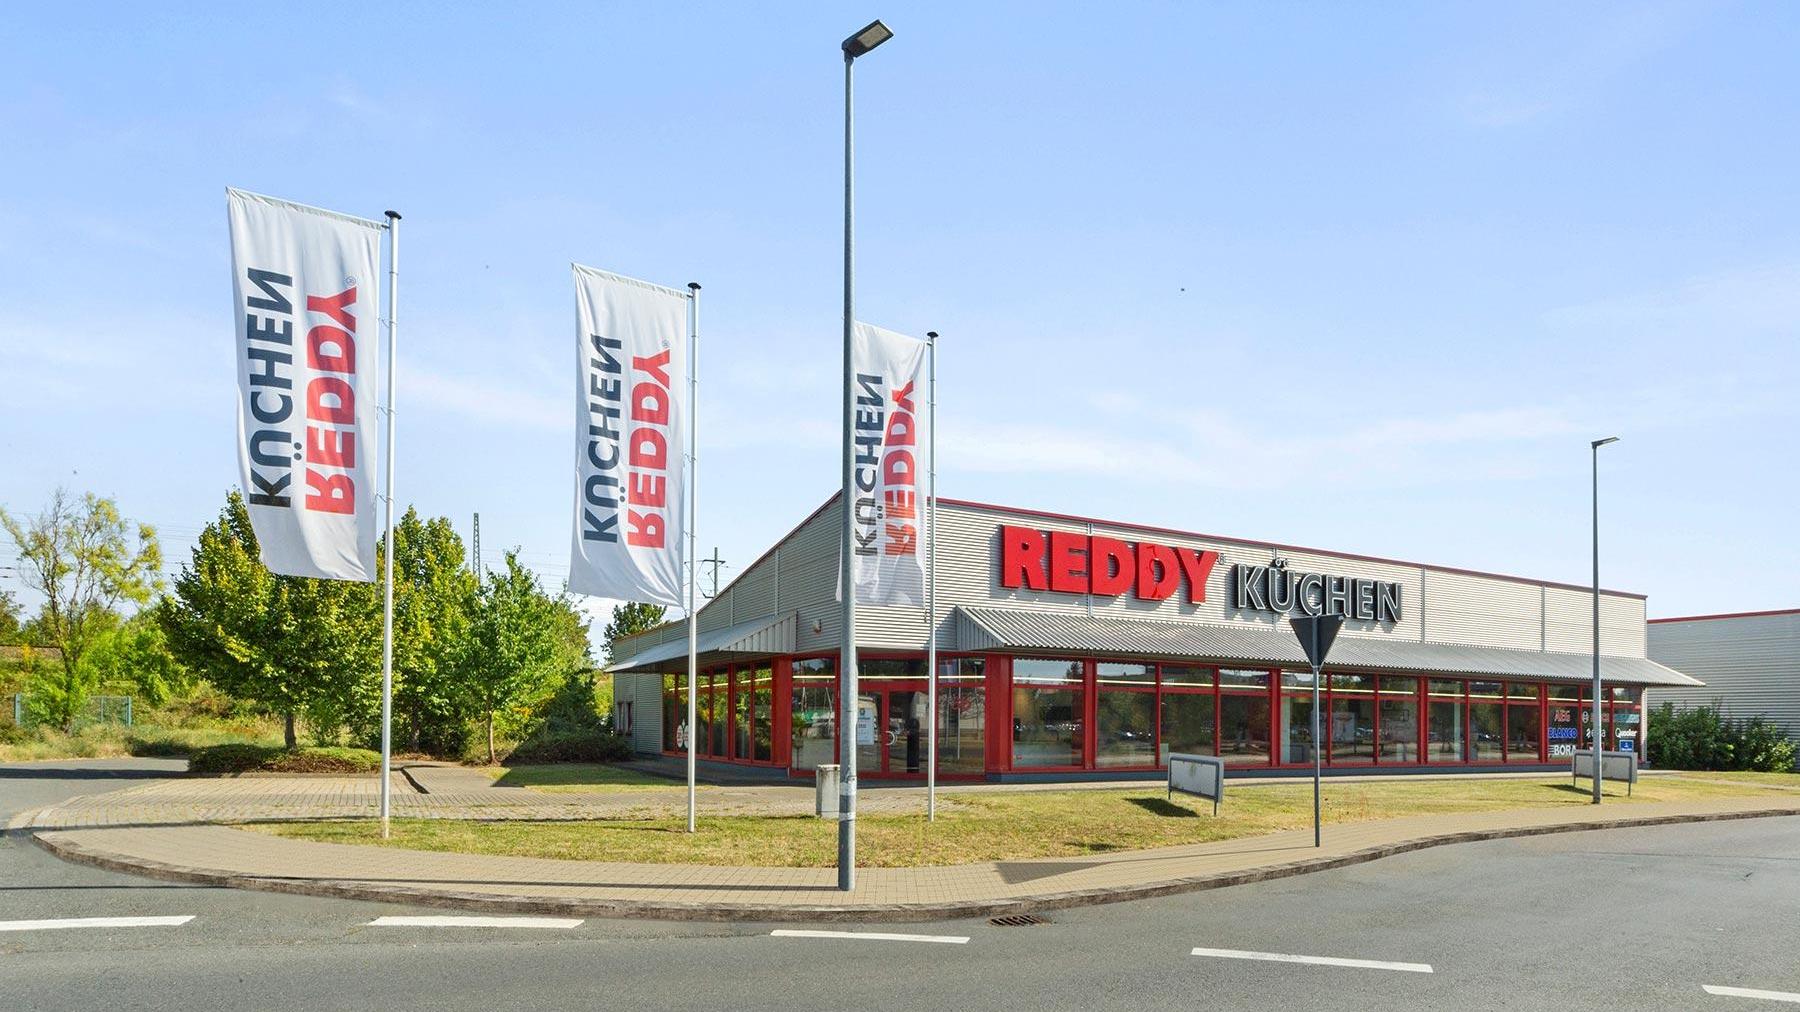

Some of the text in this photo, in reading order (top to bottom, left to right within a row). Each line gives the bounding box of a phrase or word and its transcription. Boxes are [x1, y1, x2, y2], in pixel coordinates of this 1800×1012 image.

[1001, 524, 1403, 623] REDDY KÜCHEN
[1548, 727, 1578, 739] BLANCO
[1554, 744, 1577, 756] BORA
